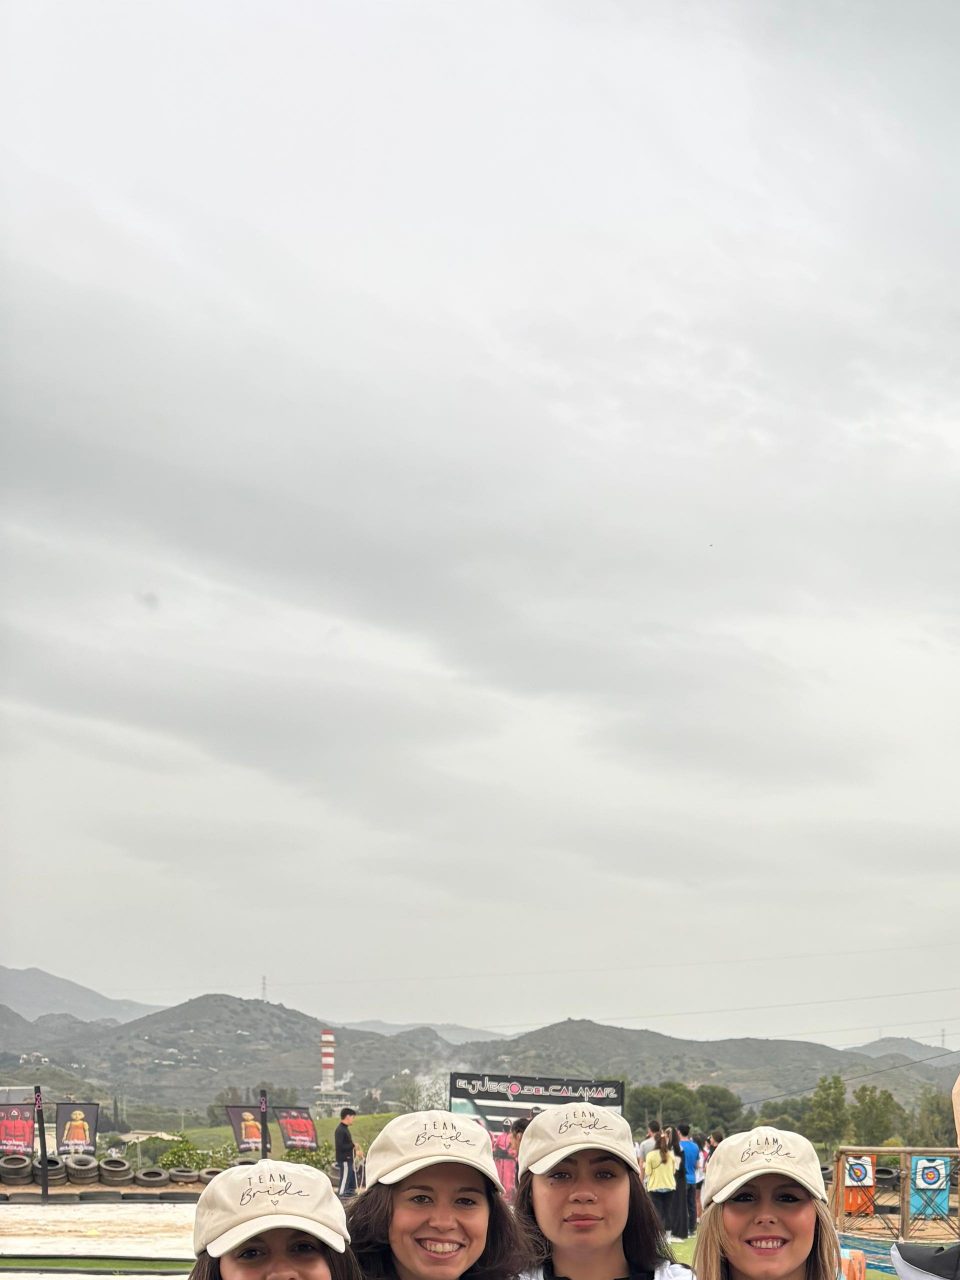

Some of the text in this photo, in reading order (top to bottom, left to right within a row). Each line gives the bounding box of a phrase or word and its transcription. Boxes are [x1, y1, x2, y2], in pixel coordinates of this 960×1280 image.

[468, 1076, 521, 1101] JUEGO
[549, 1085, 618, 1101] CALAMAR
[424, 1121, 457, 1131] TEAM
[559, 1118, 614, 1134] Bride
[414, 1132, 476, 1146] Bride
[248, 1174, 286, 1186] TEAM
[240, 1181, 310, 1206] Bride
